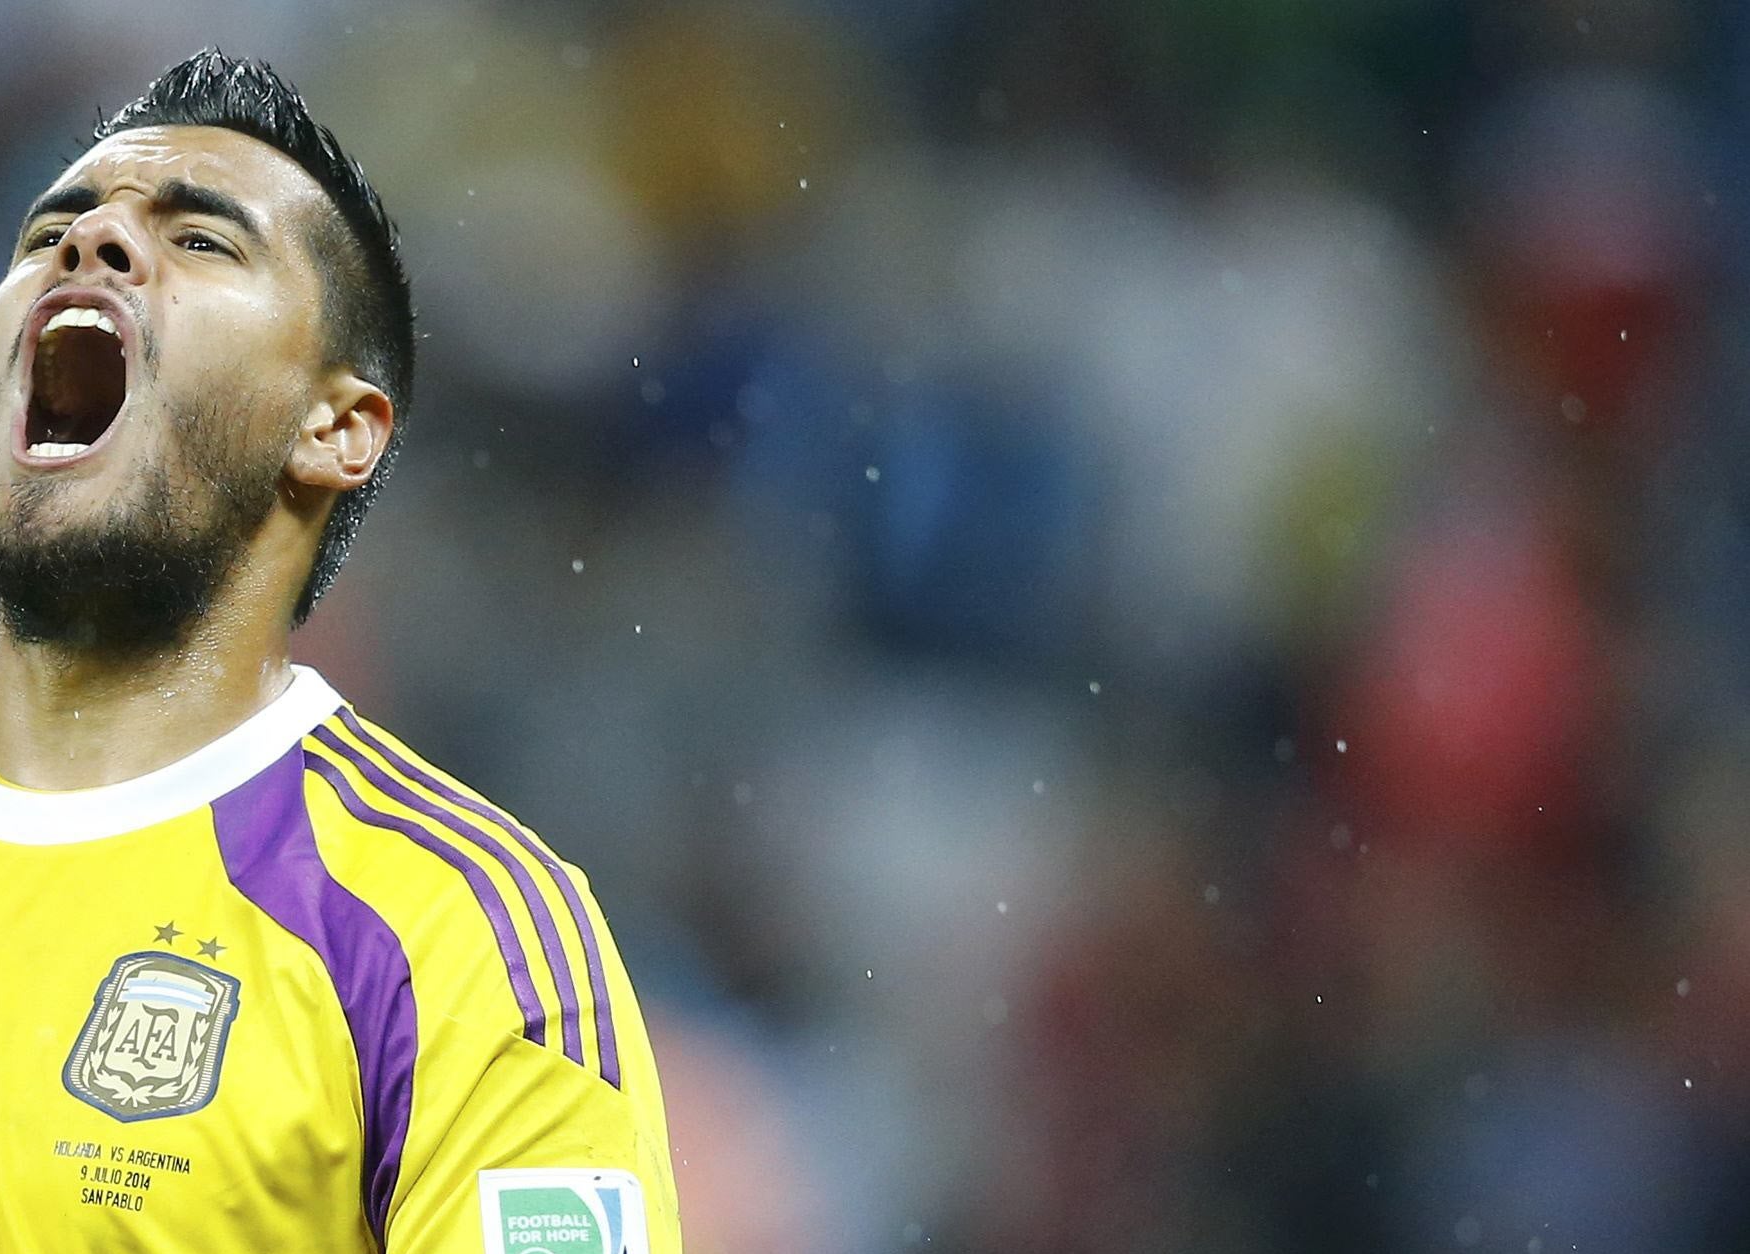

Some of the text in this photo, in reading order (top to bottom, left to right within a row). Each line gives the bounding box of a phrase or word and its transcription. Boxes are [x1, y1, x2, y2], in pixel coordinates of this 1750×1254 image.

[114, 1002, 179, 1070] AFA
[53, 1140, 191, 1174] HOLANDA VS ARGENTINA
[80, 1165, 152, 1191] 9 JULIO 2014
[81, 1188, 143, 1212] SAN PABLO
[507, 1214, 591, 1229] FOOTBALL
[509, 1228, 590, 1244] FOR HOPE
